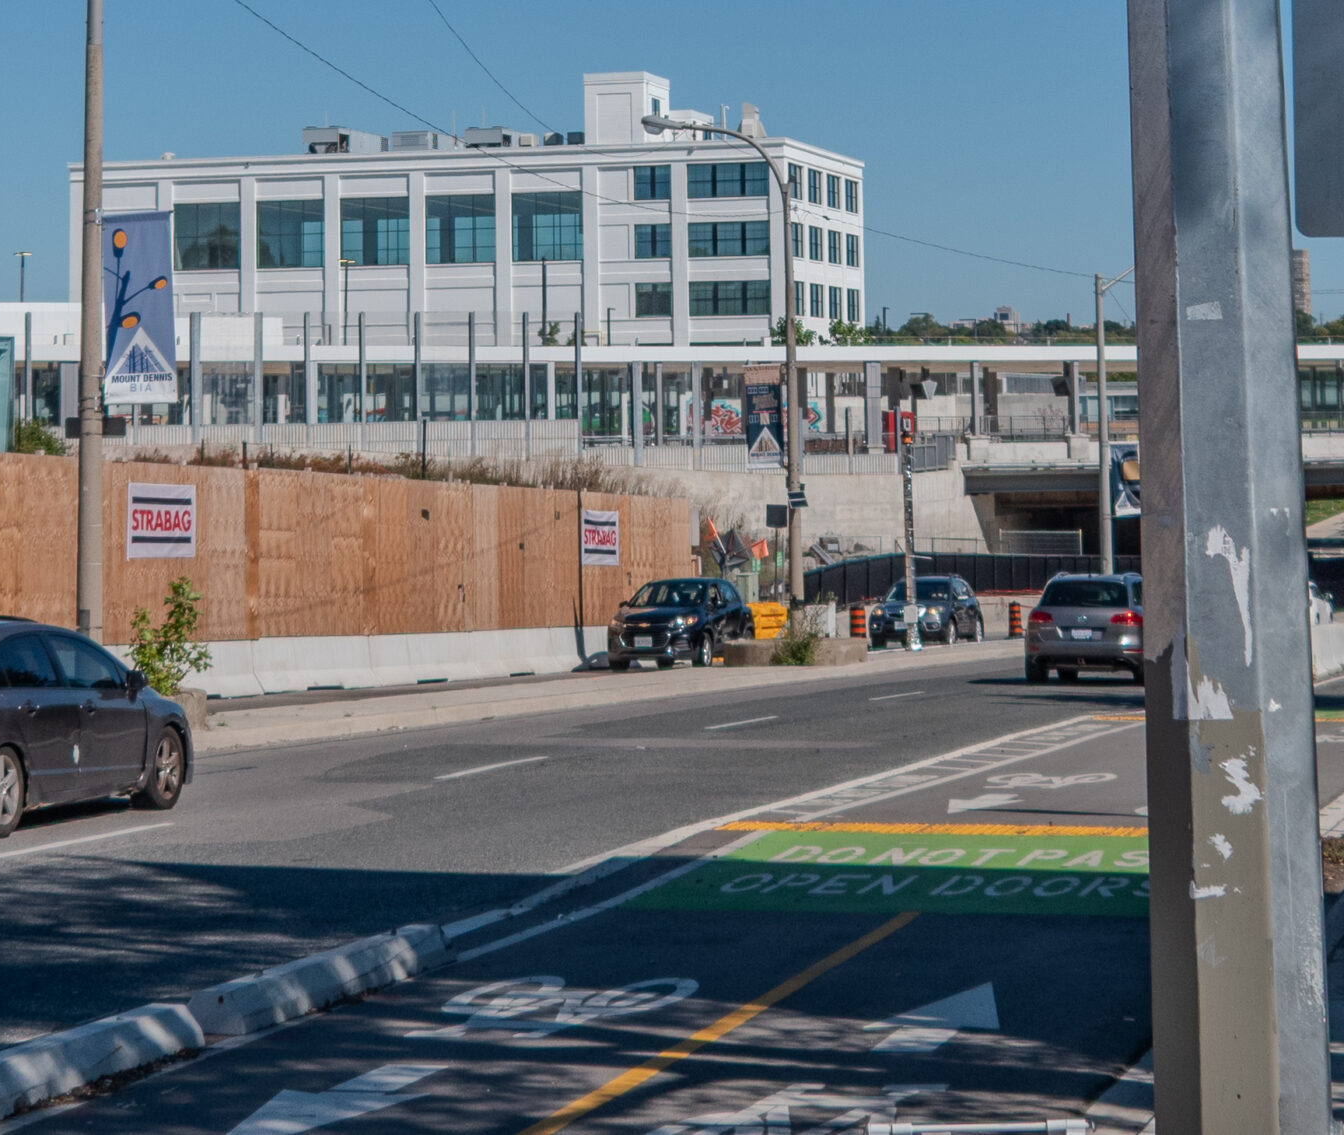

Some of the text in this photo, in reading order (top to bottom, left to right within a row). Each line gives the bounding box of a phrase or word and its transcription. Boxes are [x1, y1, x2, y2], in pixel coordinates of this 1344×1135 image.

[112, 372, 173, 384] MOUNT DENNIS
[132, 508, 192, 533] STRABAG
[584, 528, 617, 546] STRABAG
[769, 845, 1150, 868] DO NOT PAS
[719, 873, 920, 895] OPEN
